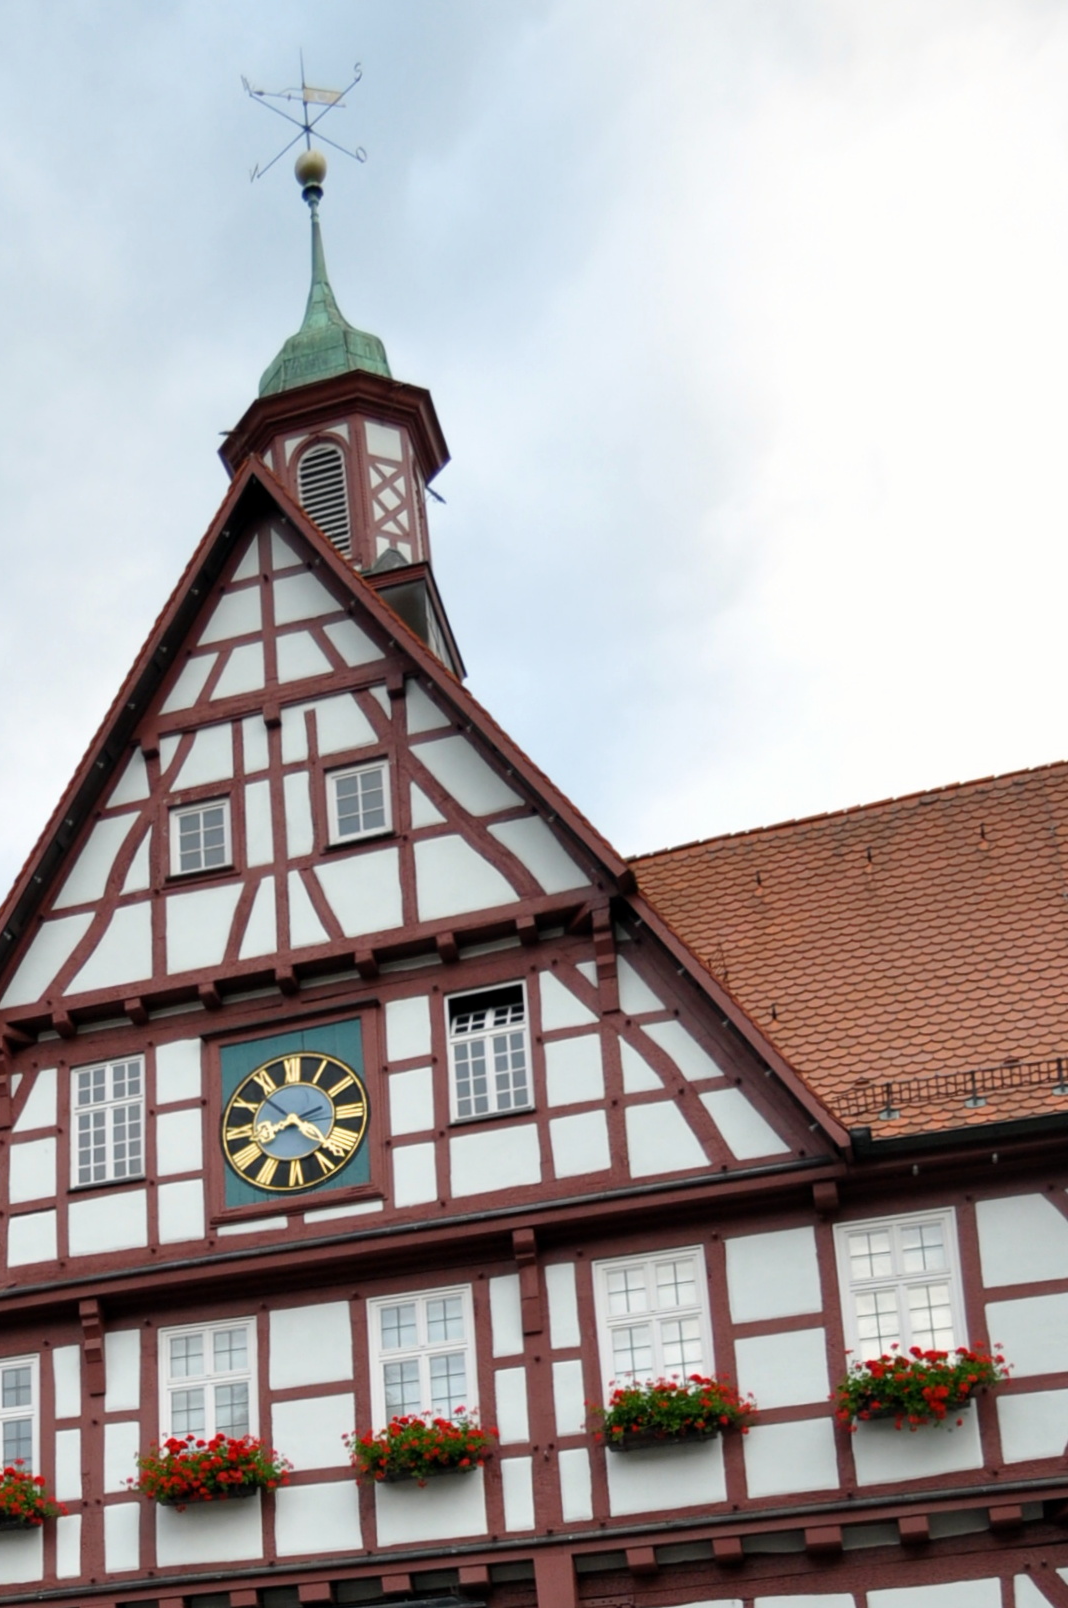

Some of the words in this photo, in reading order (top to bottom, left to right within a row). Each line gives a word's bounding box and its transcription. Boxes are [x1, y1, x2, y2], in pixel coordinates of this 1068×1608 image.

[283, 1057, 301, 1084] XII
[252, 1069, 277, 1096] XI
[327, 1075, 354, 1098] II
[233, 1096, 259, 1113] X
[335, 1102, 364, 1120] III
[226, 1123, 254, 1141] IX
[255, 1157, 279, 1185] VII
[288, 1160, 304, 1187] VI
[314, 1151, 335, 1174] V
